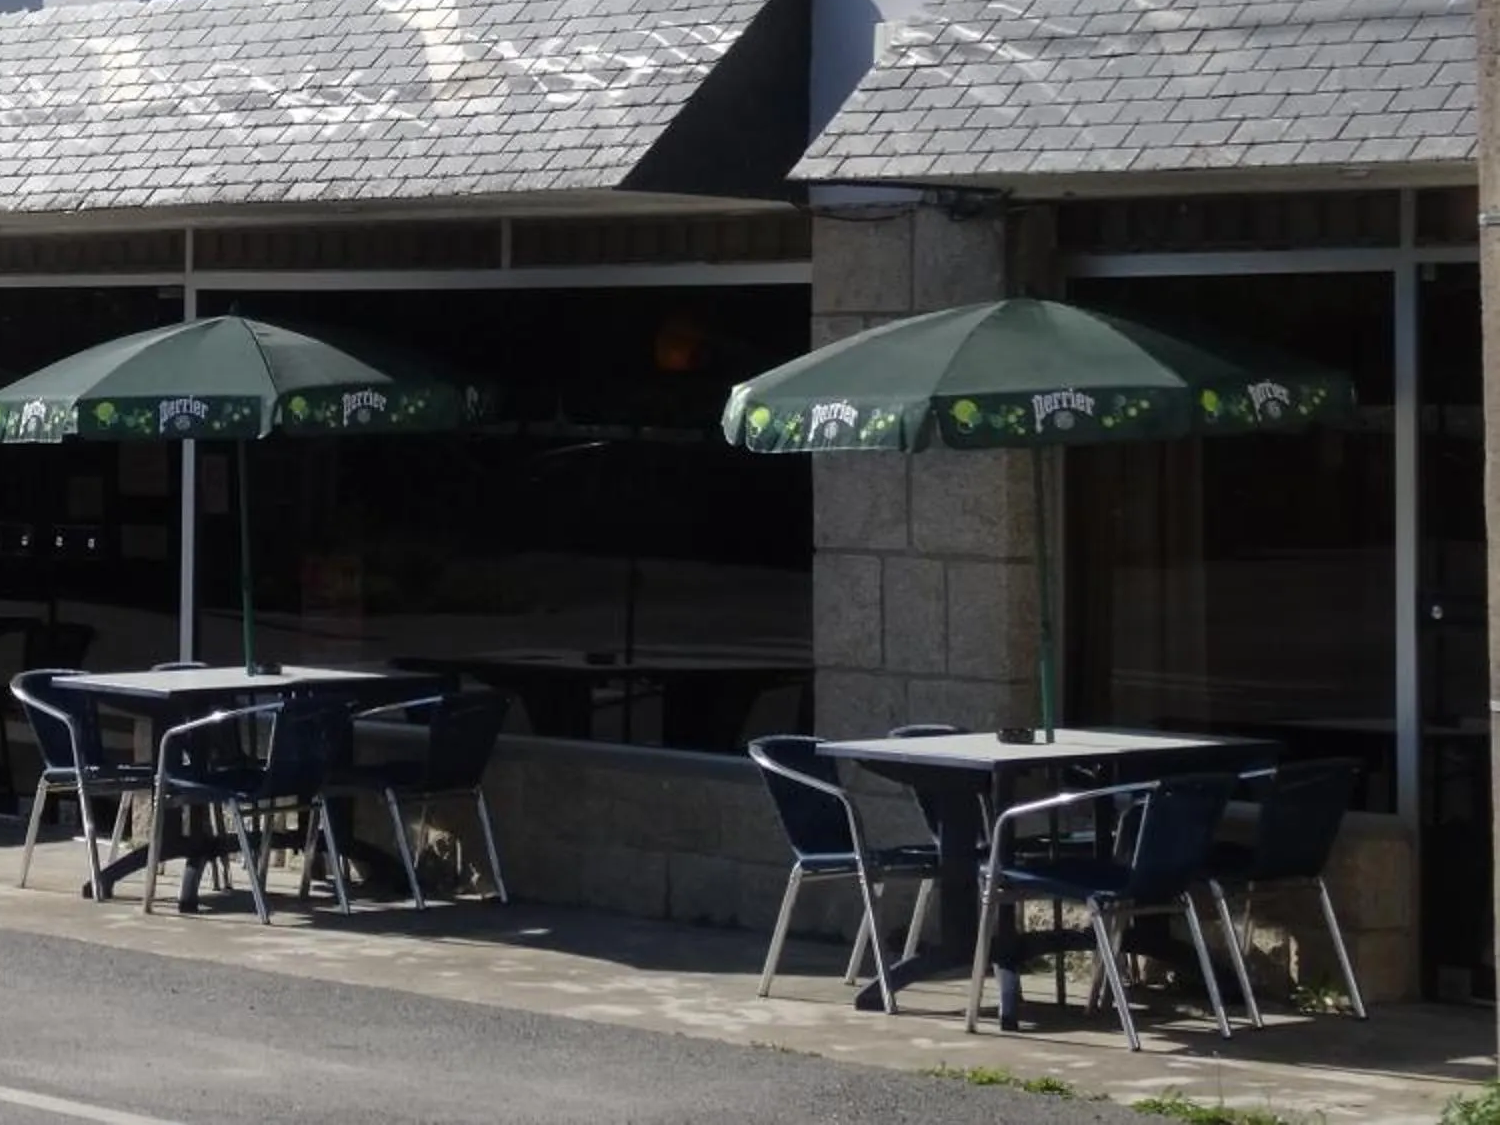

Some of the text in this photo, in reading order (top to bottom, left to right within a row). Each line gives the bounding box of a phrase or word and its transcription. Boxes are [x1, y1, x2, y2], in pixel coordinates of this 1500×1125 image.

[159, 394, 210, 434] Perrier
[341, 387, 388, 427] Perrier
[807, 398, 860, 443] Perrier
[1031, 387, 1096, 434] Perrier
